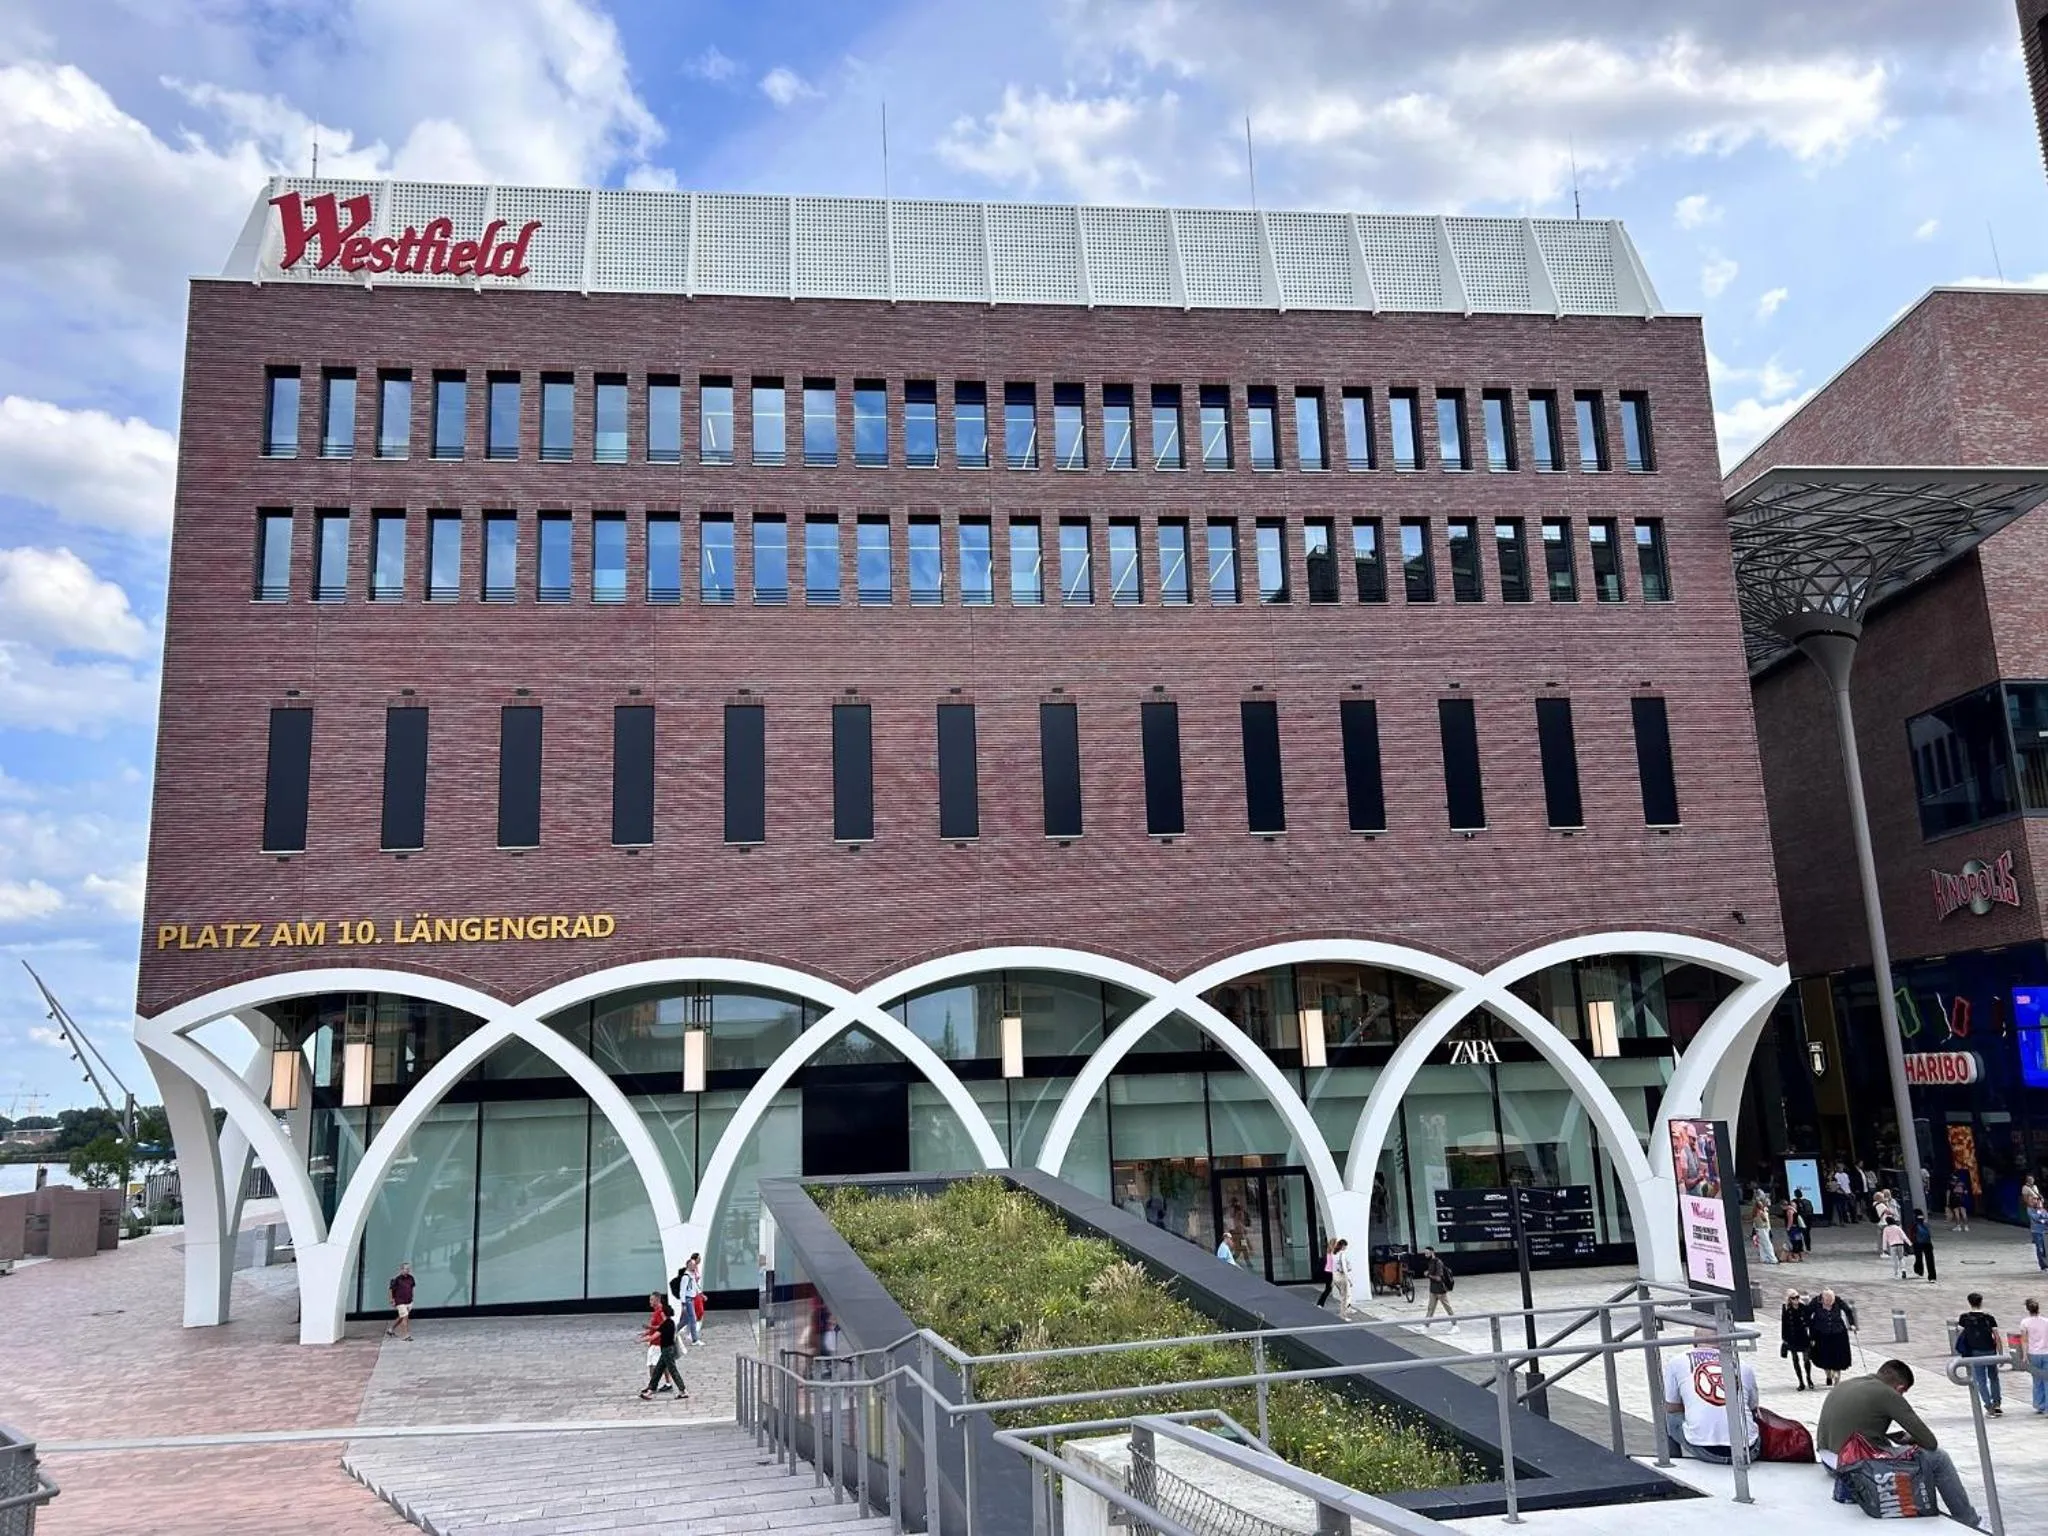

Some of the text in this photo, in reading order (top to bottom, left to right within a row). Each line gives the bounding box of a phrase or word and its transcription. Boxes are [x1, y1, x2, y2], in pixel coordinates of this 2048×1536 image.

[268, 191, 543, 278] Westfield
[157, 912, 616, 950] PLATZ AM 10. LÄNGENGRAD
[1448, 1039, 1502, 1065] ZARA
[1904, 1054, 1969, 1082] HARIBO
